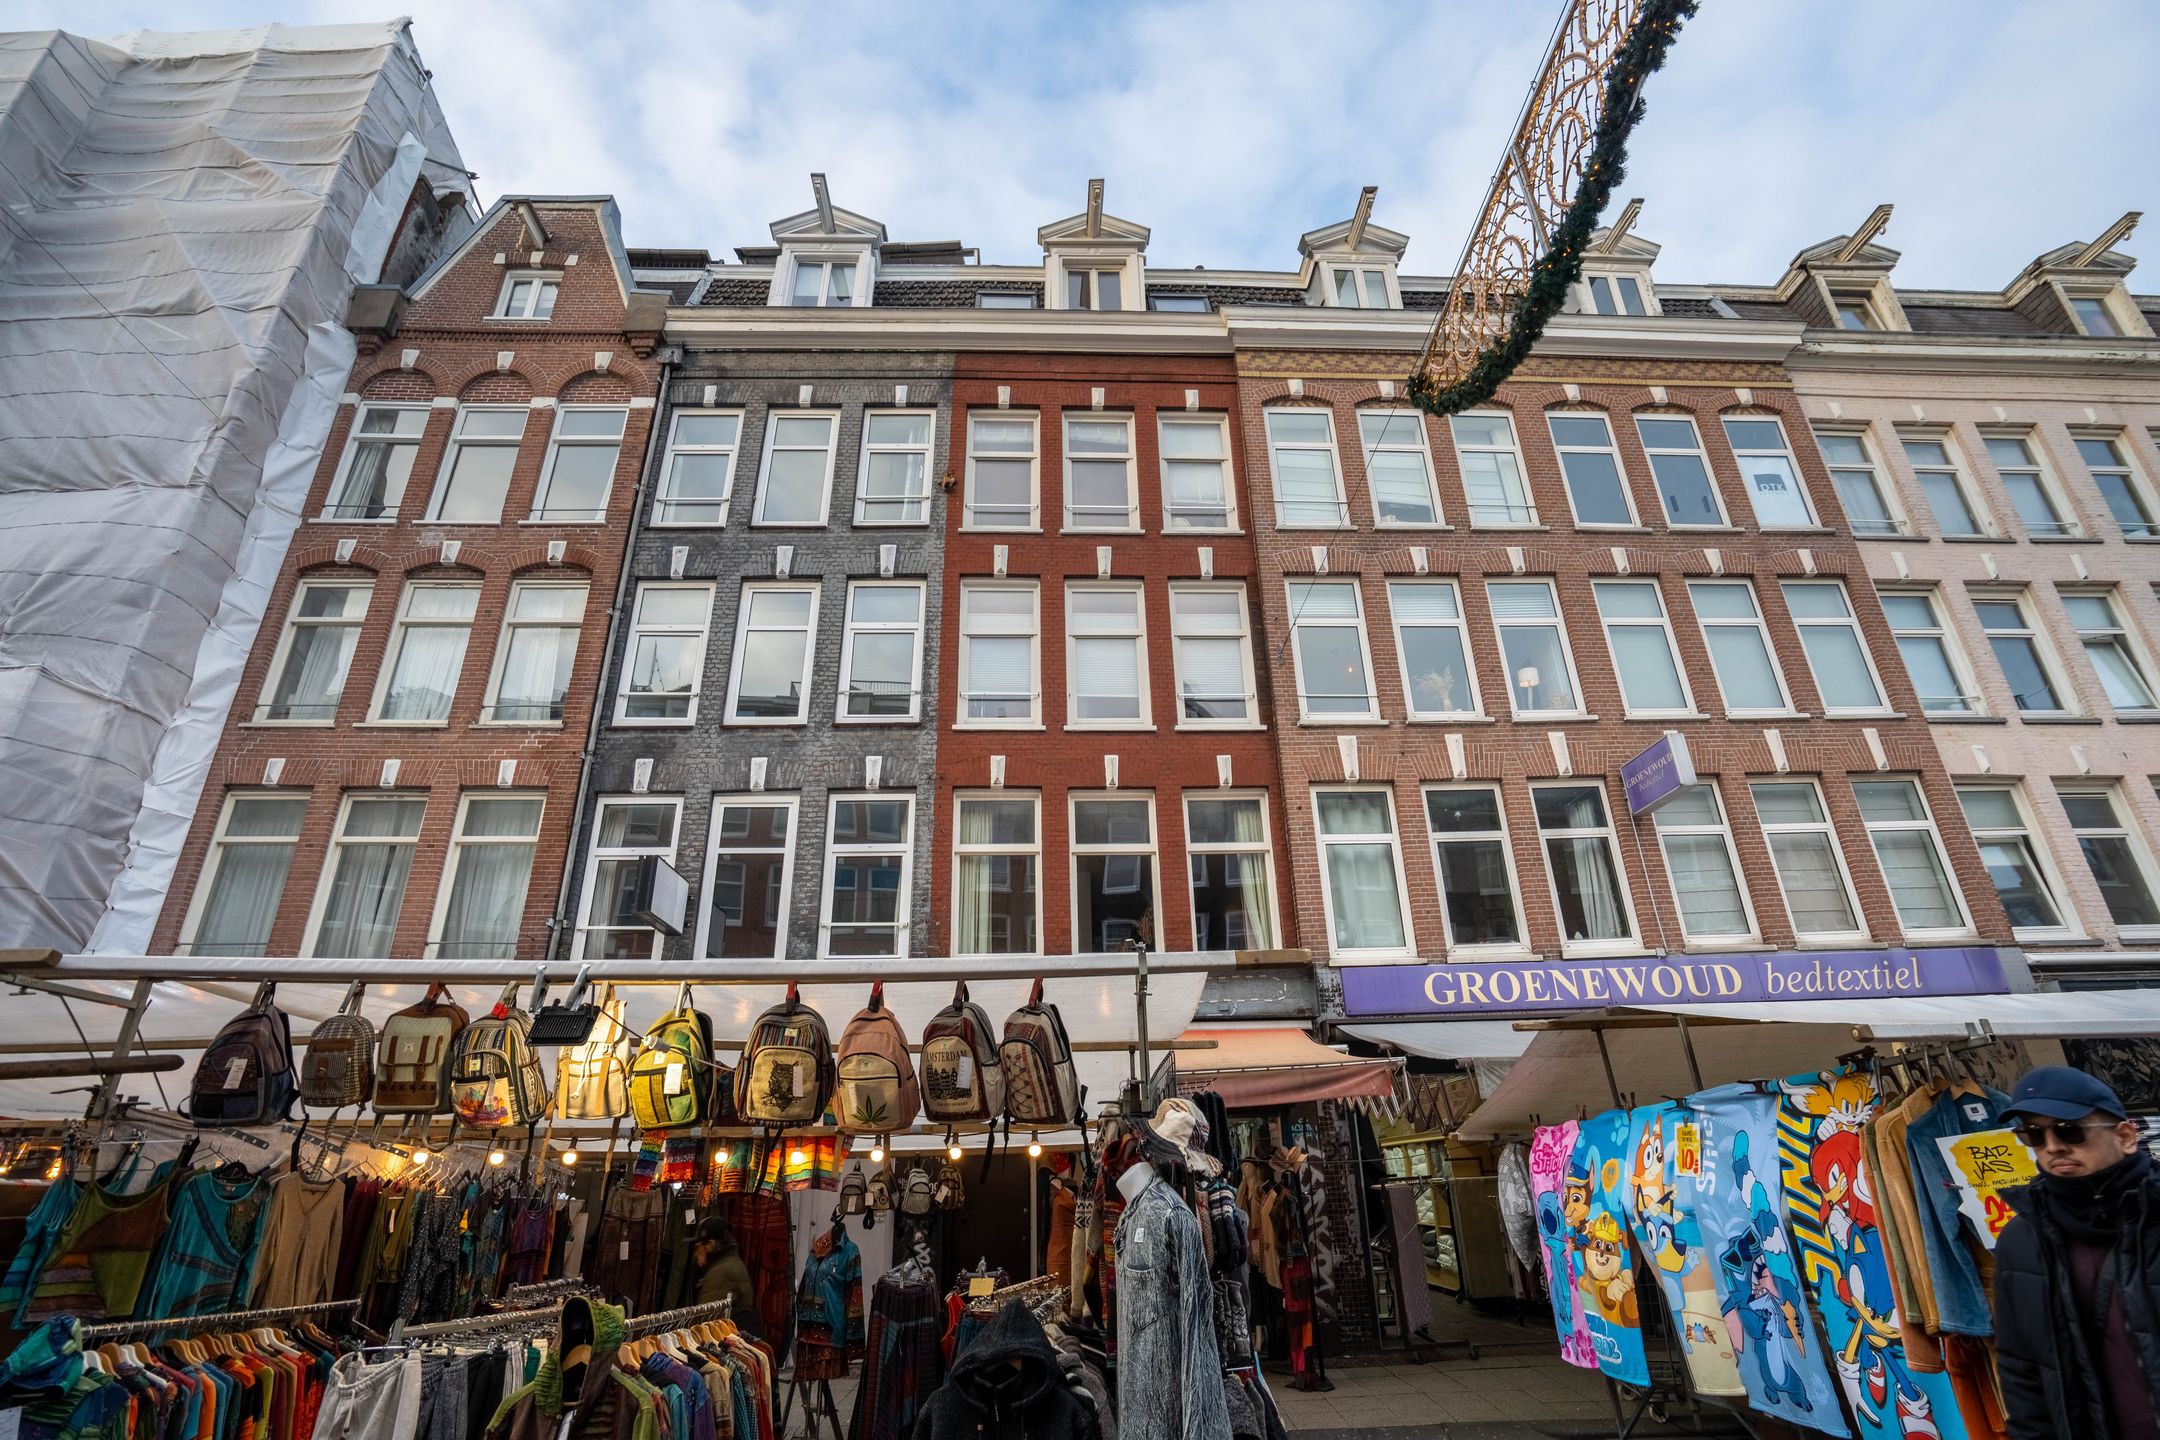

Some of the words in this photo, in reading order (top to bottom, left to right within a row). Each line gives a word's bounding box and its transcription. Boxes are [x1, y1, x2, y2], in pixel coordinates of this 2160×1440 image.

[1626, 752, 1674, 789] GROENEWOUD
[1424, 963, 1742, 1006] GROENEWOUD
[1764, 957, 1924, 994] bedtextiel
[1973, 1160, 2014, 1180] JAS
